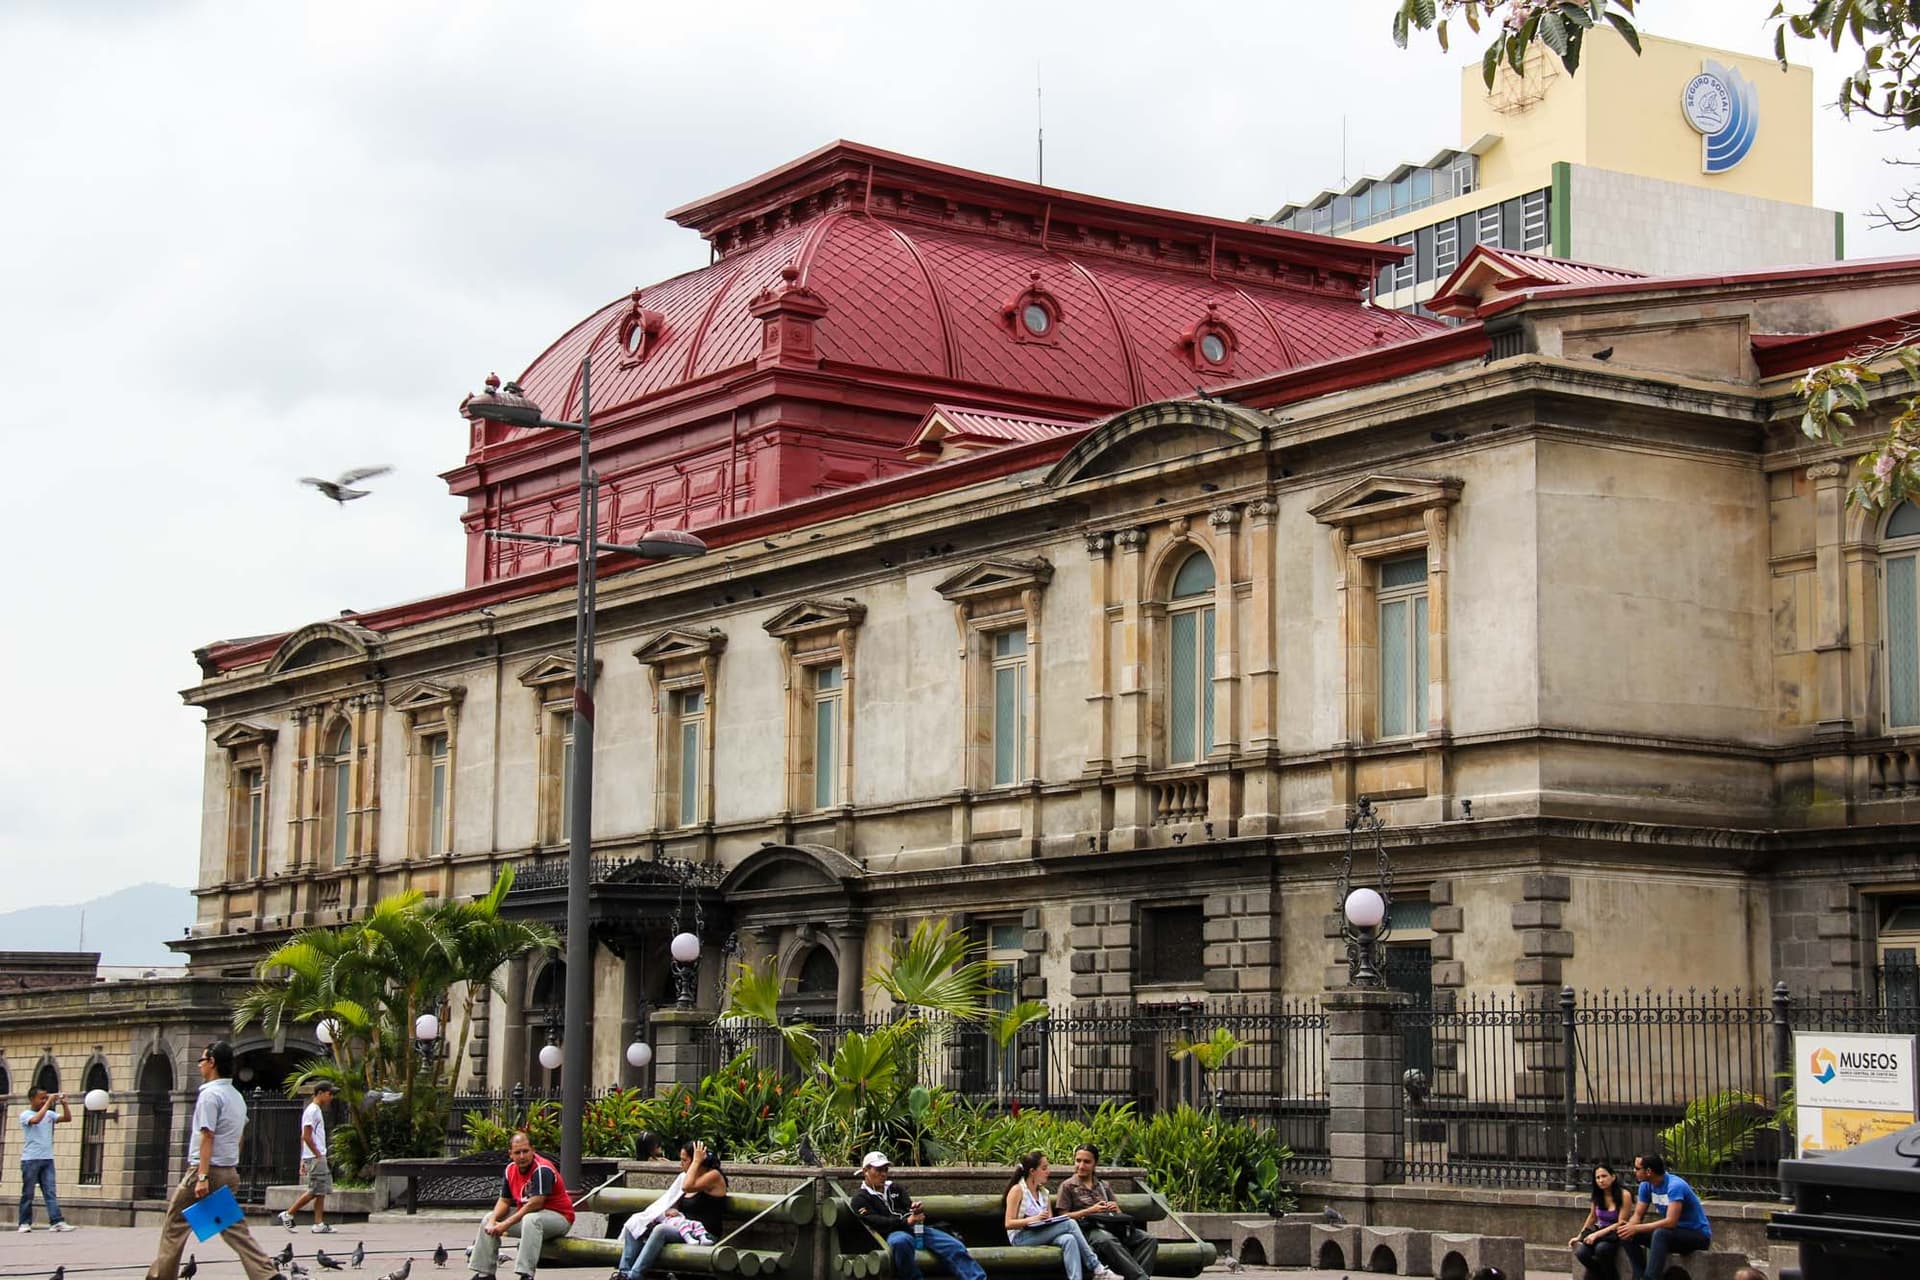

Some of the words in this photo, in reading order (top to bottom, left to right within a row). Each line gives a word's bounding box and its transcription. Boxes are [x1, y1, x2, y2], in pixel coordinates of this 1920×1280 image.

[1688, 77, 1709, 107] SEGURO
[1711, 80, 1728, 112] SOCIAL
[1840, 1052, 1898, 1070] MUSEOS
